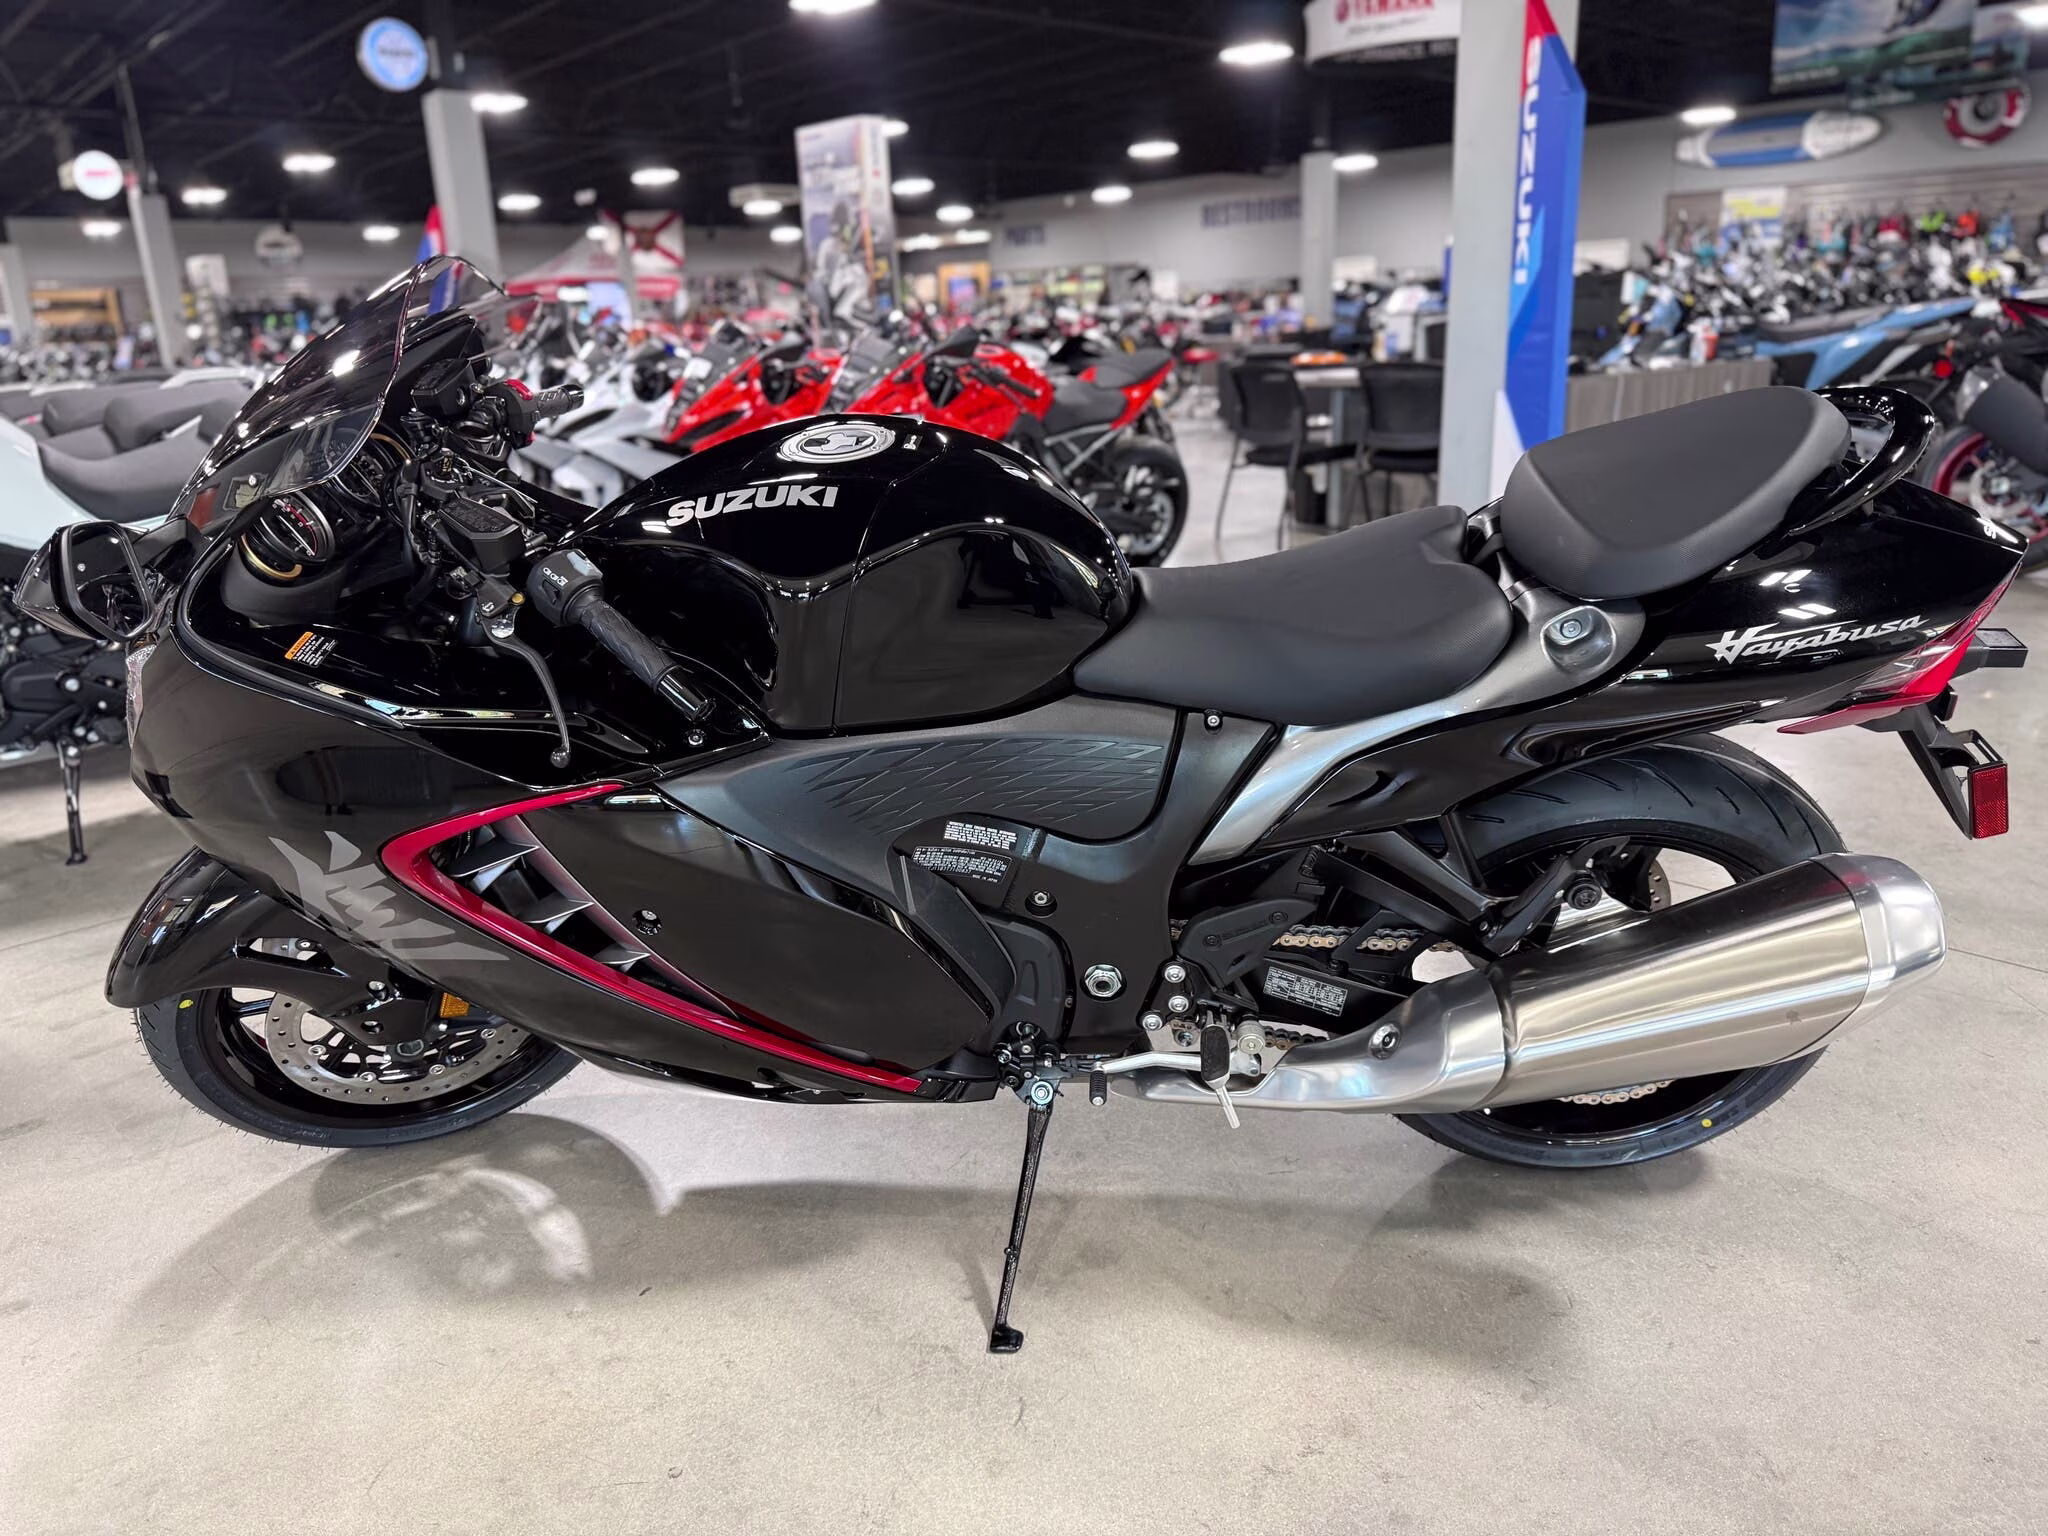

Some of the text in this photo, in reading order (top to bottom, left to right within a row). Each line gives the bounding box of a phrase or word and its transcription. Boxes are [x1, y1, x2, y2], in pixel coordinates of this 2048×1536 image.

[1514, 35, 1542, 285] SUZUKI
[666, 485, 840, 527] SUZUKI
[1704, 614, 1931, 665] Hayabusa
